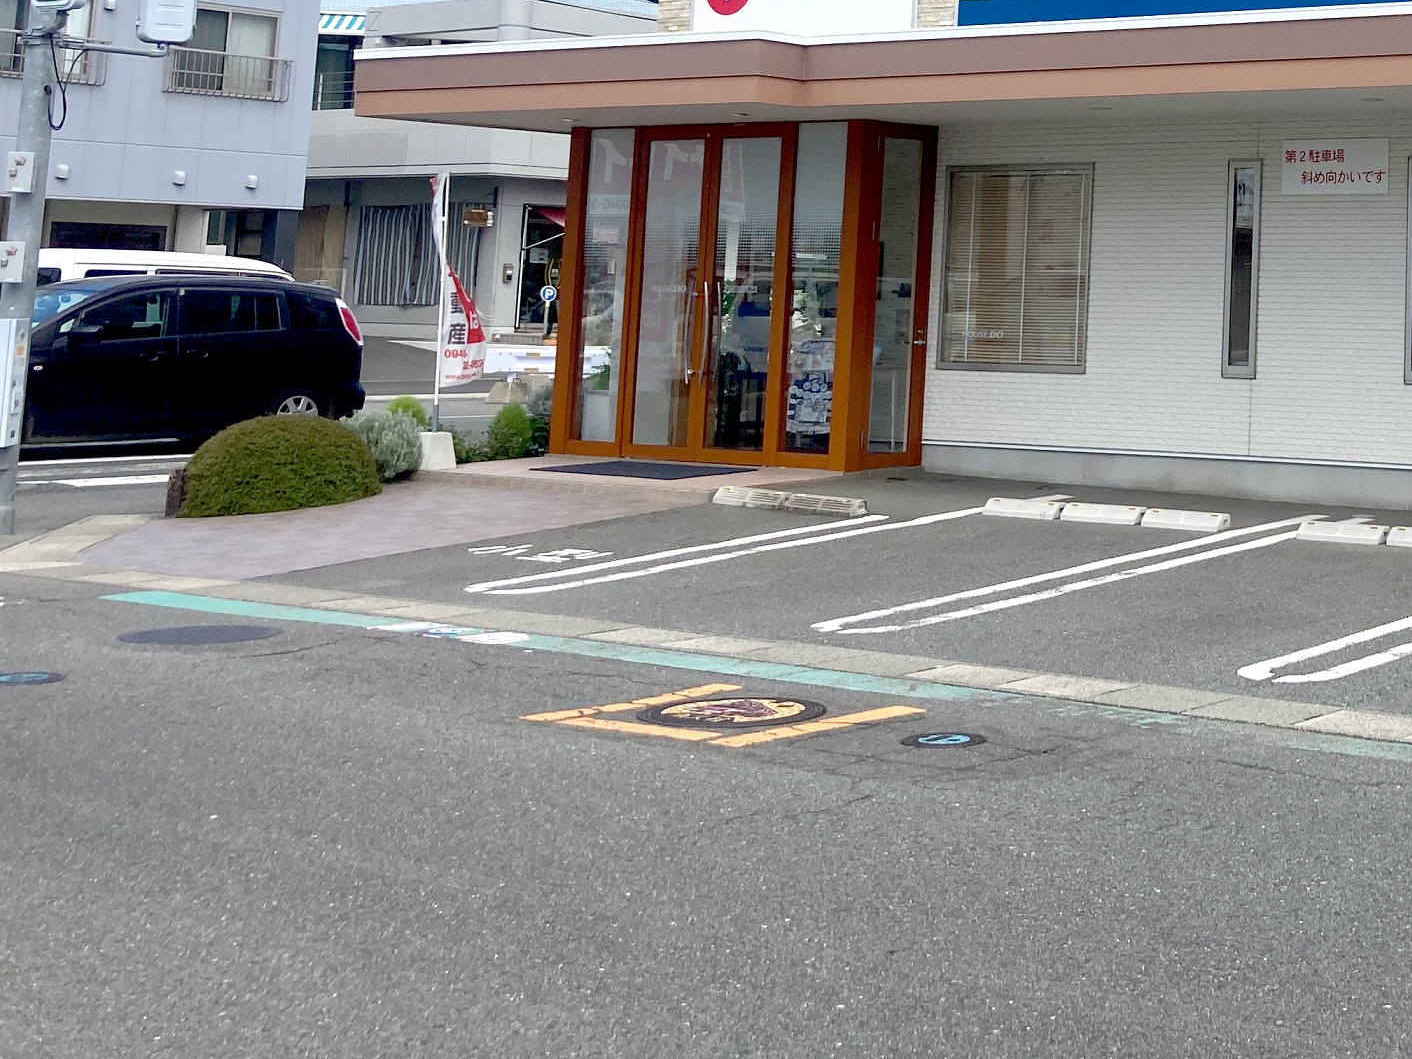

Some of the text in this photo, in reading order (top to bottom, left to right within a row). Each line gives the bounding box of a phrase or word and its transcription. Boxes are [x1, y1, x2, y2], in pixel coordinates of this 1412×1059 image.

[1285, 148, 1345, 164] 第2駐車場
[1301, 170, 1386, 186] 斜め向かいです
